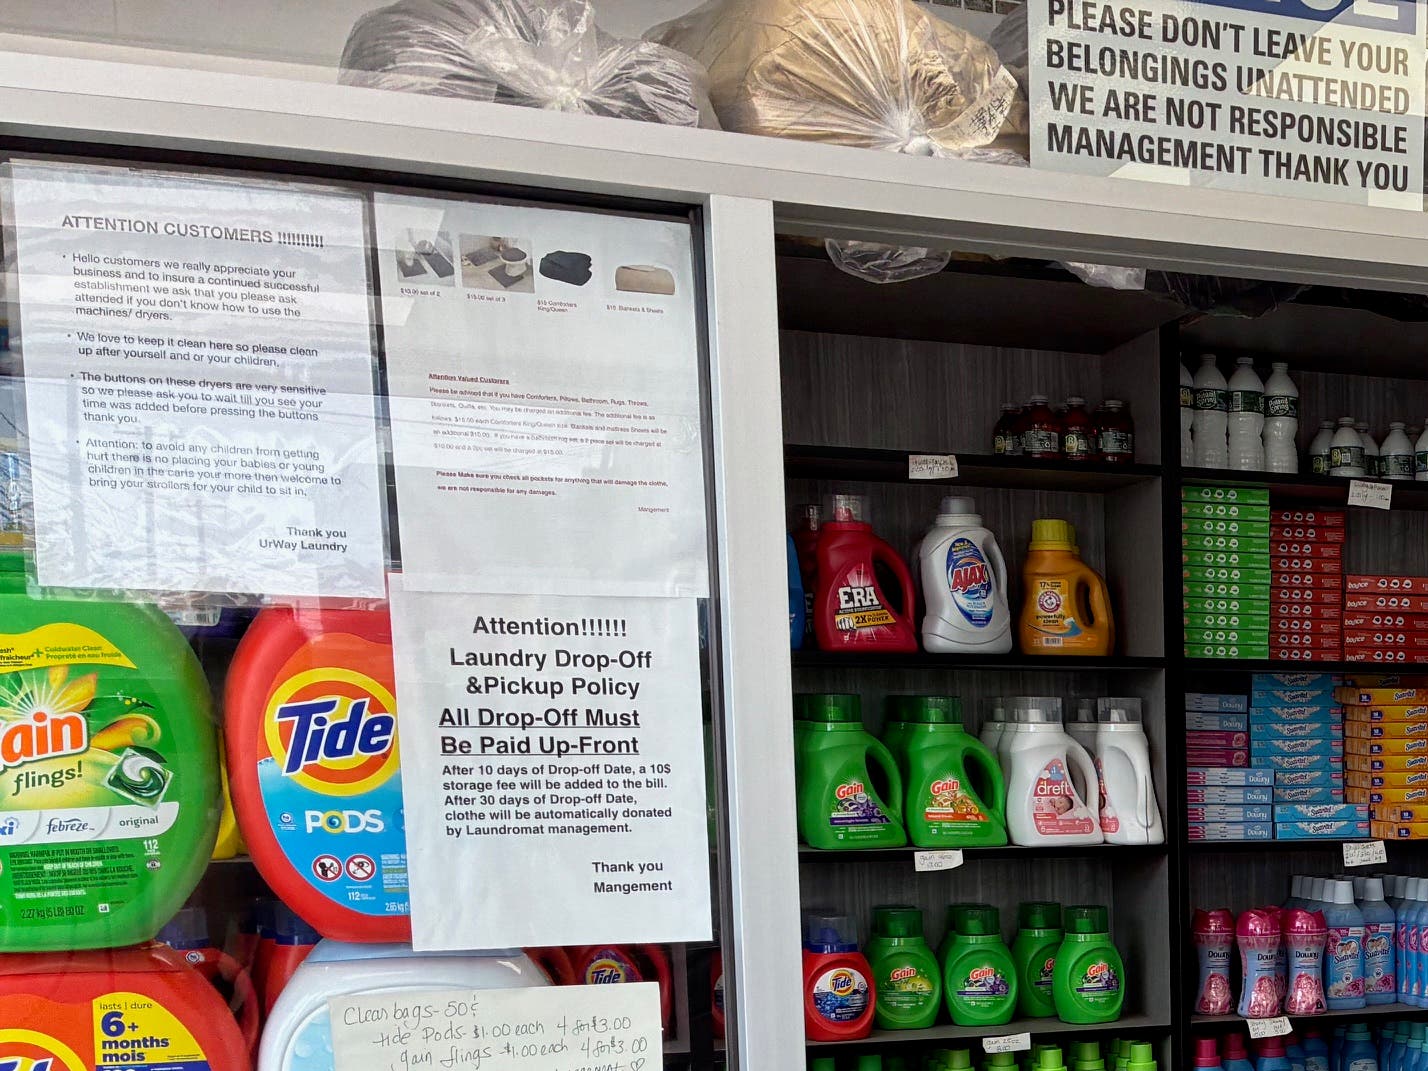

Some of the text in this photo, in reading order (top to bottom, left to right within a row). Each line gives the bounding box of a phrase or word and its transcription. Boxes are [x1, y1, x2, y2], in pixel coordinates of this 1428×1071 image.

[1049, 0, 1153, 40] PLEASE
[1162, 13, 1245, 53] DON'T
[1253, 26, 1332, 66] LEAVE
[1339, 39, 1409, 77] YOUR
[1046, 38, 1409, 116] BELONGINGS UNATTENDED
[1047, 81, 1407, 154] WE ARE NOT RESPONSIBLE
[1047, 123, 1408, 192] MANAGEMENT THANK YOU
[61, 215, 158, 233] ATTENTION
[164, 222, 272, 242] CUSTOMERS
[72, 252, 294, 278] Hello customers we really appreciate your
[79, 371, 101, 381] The
[104, 373, 145, 383] buttons
[166, 377, 195, 385] these
[198, 379, 232, 390] dryers
[235, 382, 251, 390] are
[255, 384, 277, 392] very
[280, 385, 326, 395] sensitive
[287, 526, 346, 538] Thank you
[259, 539, 347, 552] UrWay Laundry
[951, 564, 987, 594] AJAX
[838, 586, 880, 609] ERA
[450, 647, 651, 672] Laundry Drop-Off
[466, 676, 639, 699] &Pickup Policy
[438, 708, 640, 730] All Drop-Off Must
[0, 711, 85, 765] ain
[276, 697, 396, 777] Tide
[441, 736, 638, 754] Be Paid Up-Front
[12, 761, 83, 796] flings!
[442, 763, 670, 776] After 10 days of Drop-off Date, a 10$
[835, 782, 864, 799] Gain
[930, 779, 960, 796] Gain
[1037, 782, 1071, 797] dreft
[45, 817, 90, 835] febreze
[119, 815, 159, 828] original
[304, 809, 385, 834] PODS
[143, 840, 158, 850] 112
[591, 861, 662, 873] Thank you
[593, 880, 672, 894] Mangement
[890, 966, 916, 981] Gain
[969, 966, 994, 981] Gain
[1087, 962, 1109, 977] Gain
[832, 976, 852, 991] Tide
[100, 1012, 139, 1037] 6+
[101, 1036, 170, 1051] months
[102, 1049, 147, 1062] mois
